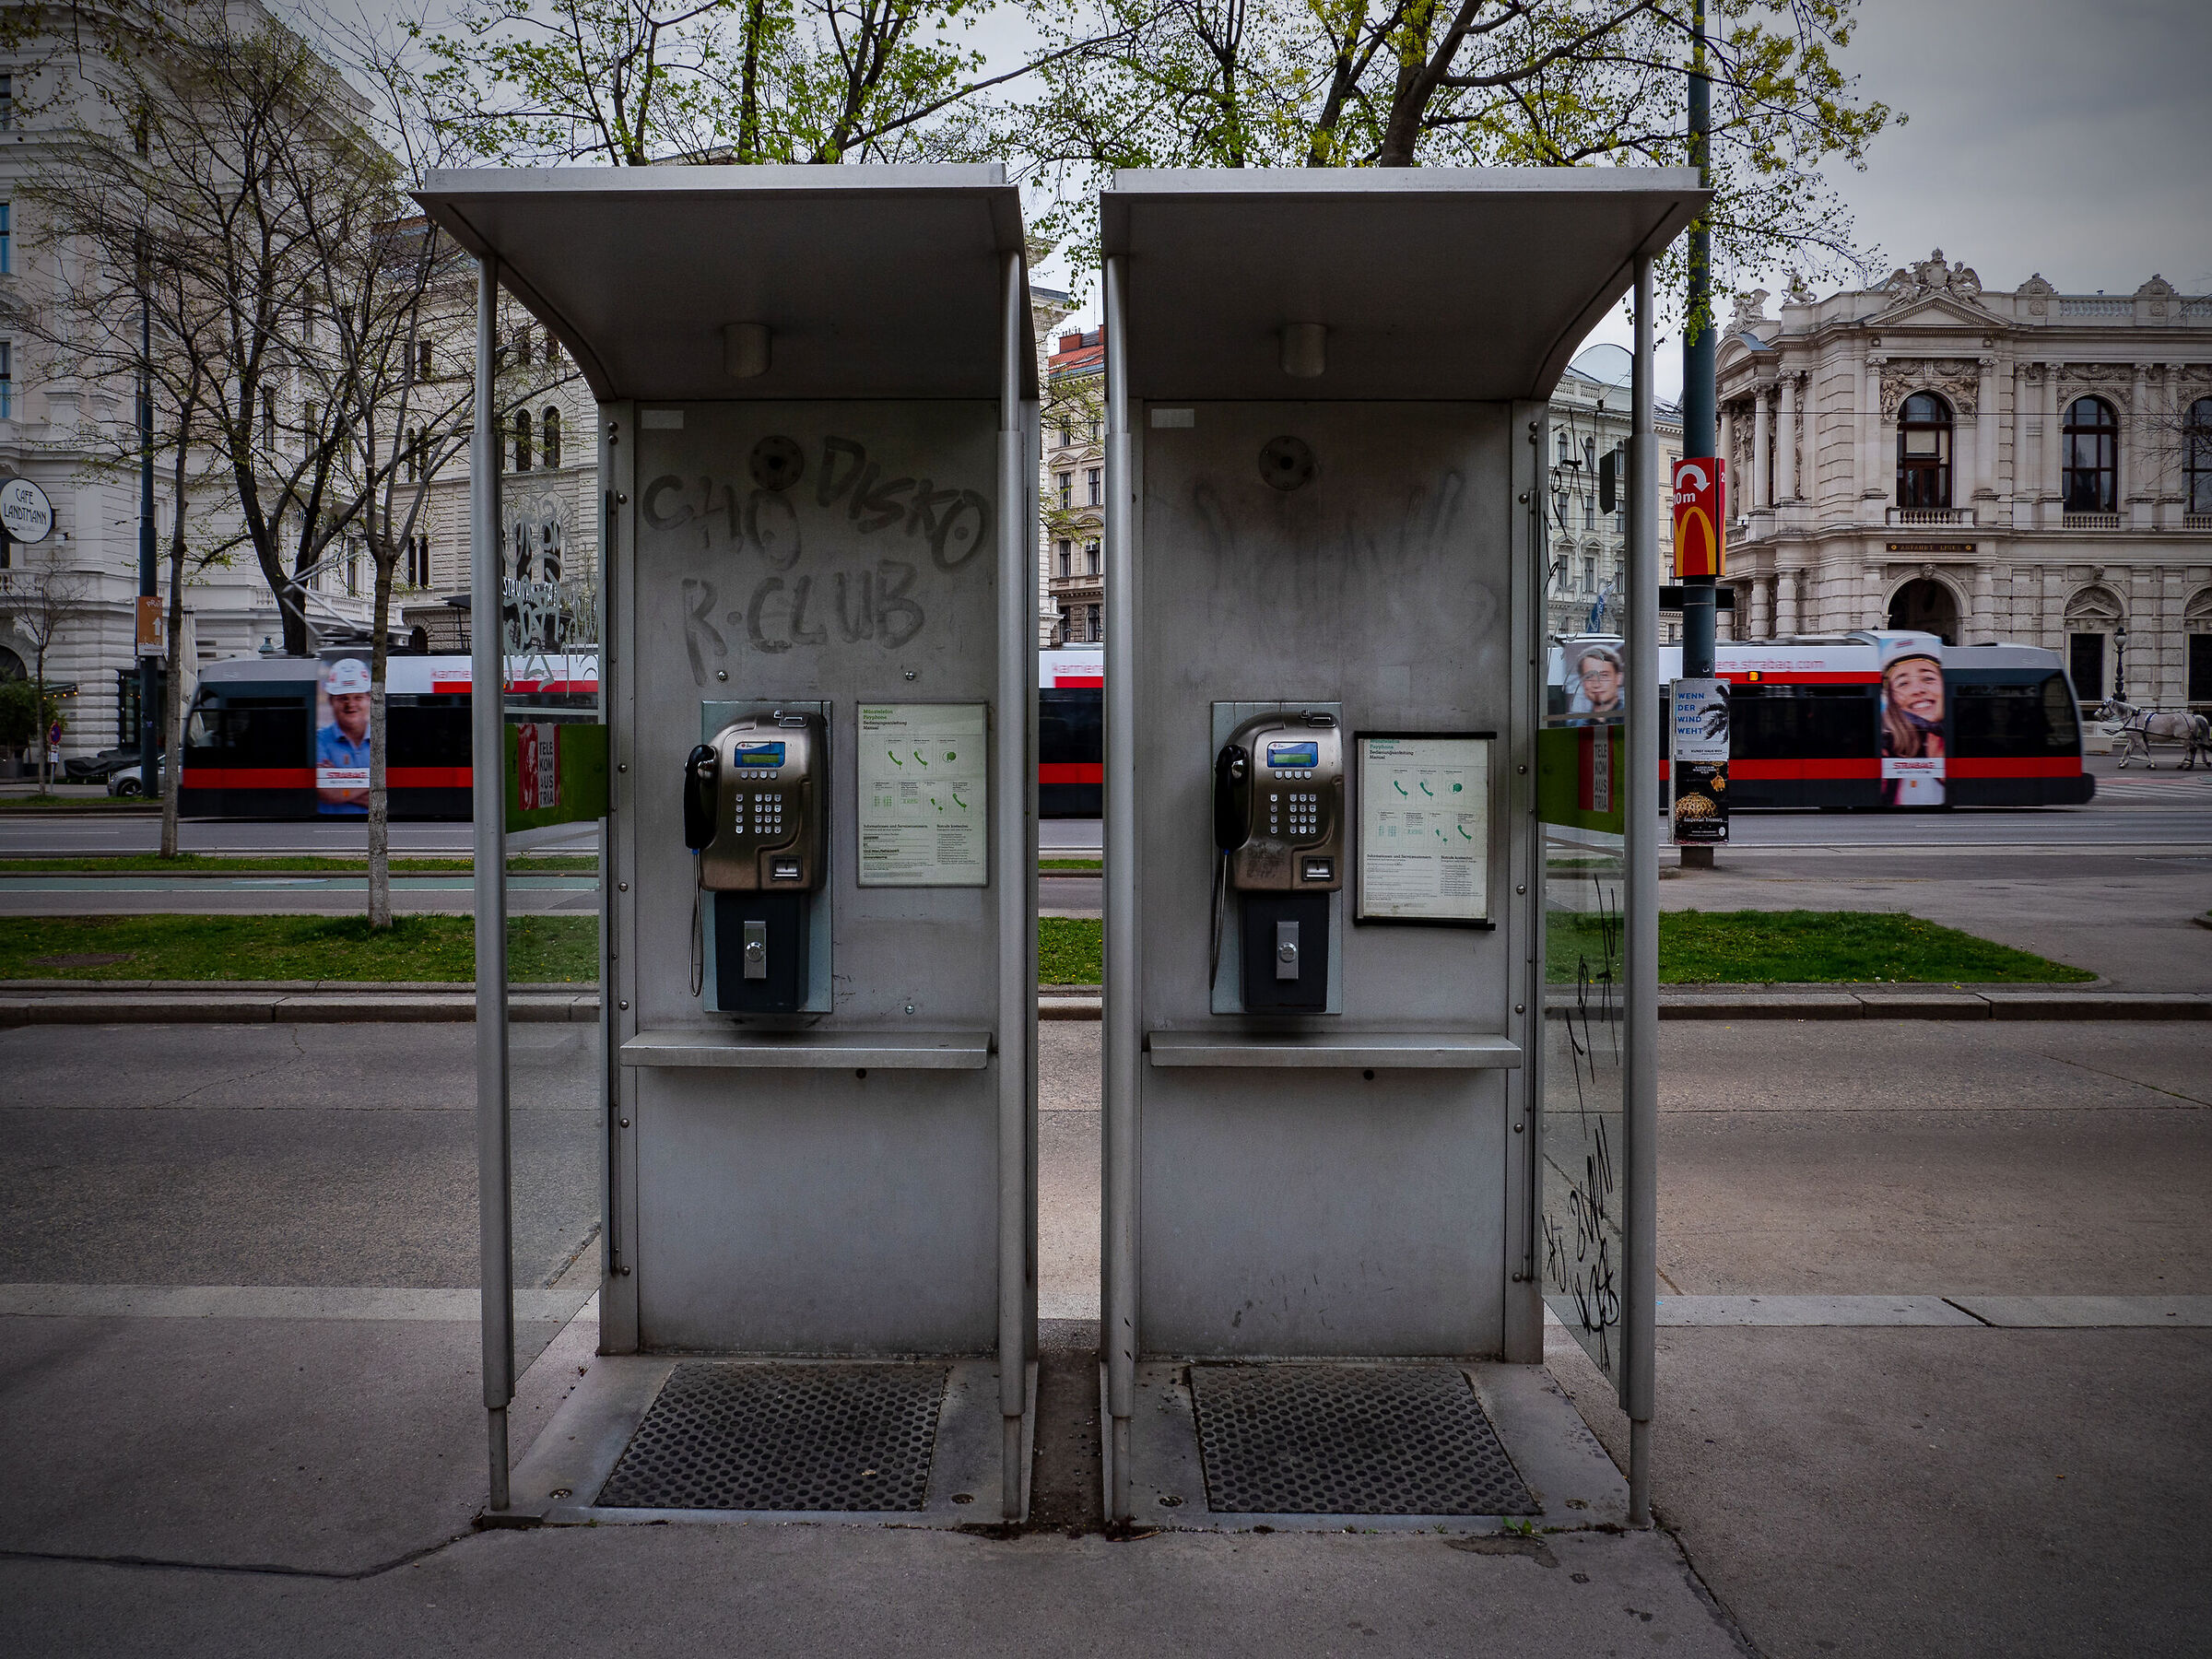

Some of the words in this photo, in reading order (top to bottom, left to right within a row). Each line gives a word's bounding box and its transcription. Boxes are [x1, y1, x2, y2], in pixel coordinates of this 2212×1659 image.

[4, 502, 47, 525] LANDTMANN
[539, 741, 553, 756] TELE
[1594, 744, 1607, 758] TELE
[539, 757, 553, 771] KOM
[1594, 779, 1607, 794] AUS
[539, 791, 553, 805] TRIA
[1594, 794, 1607, 809] TRIA
